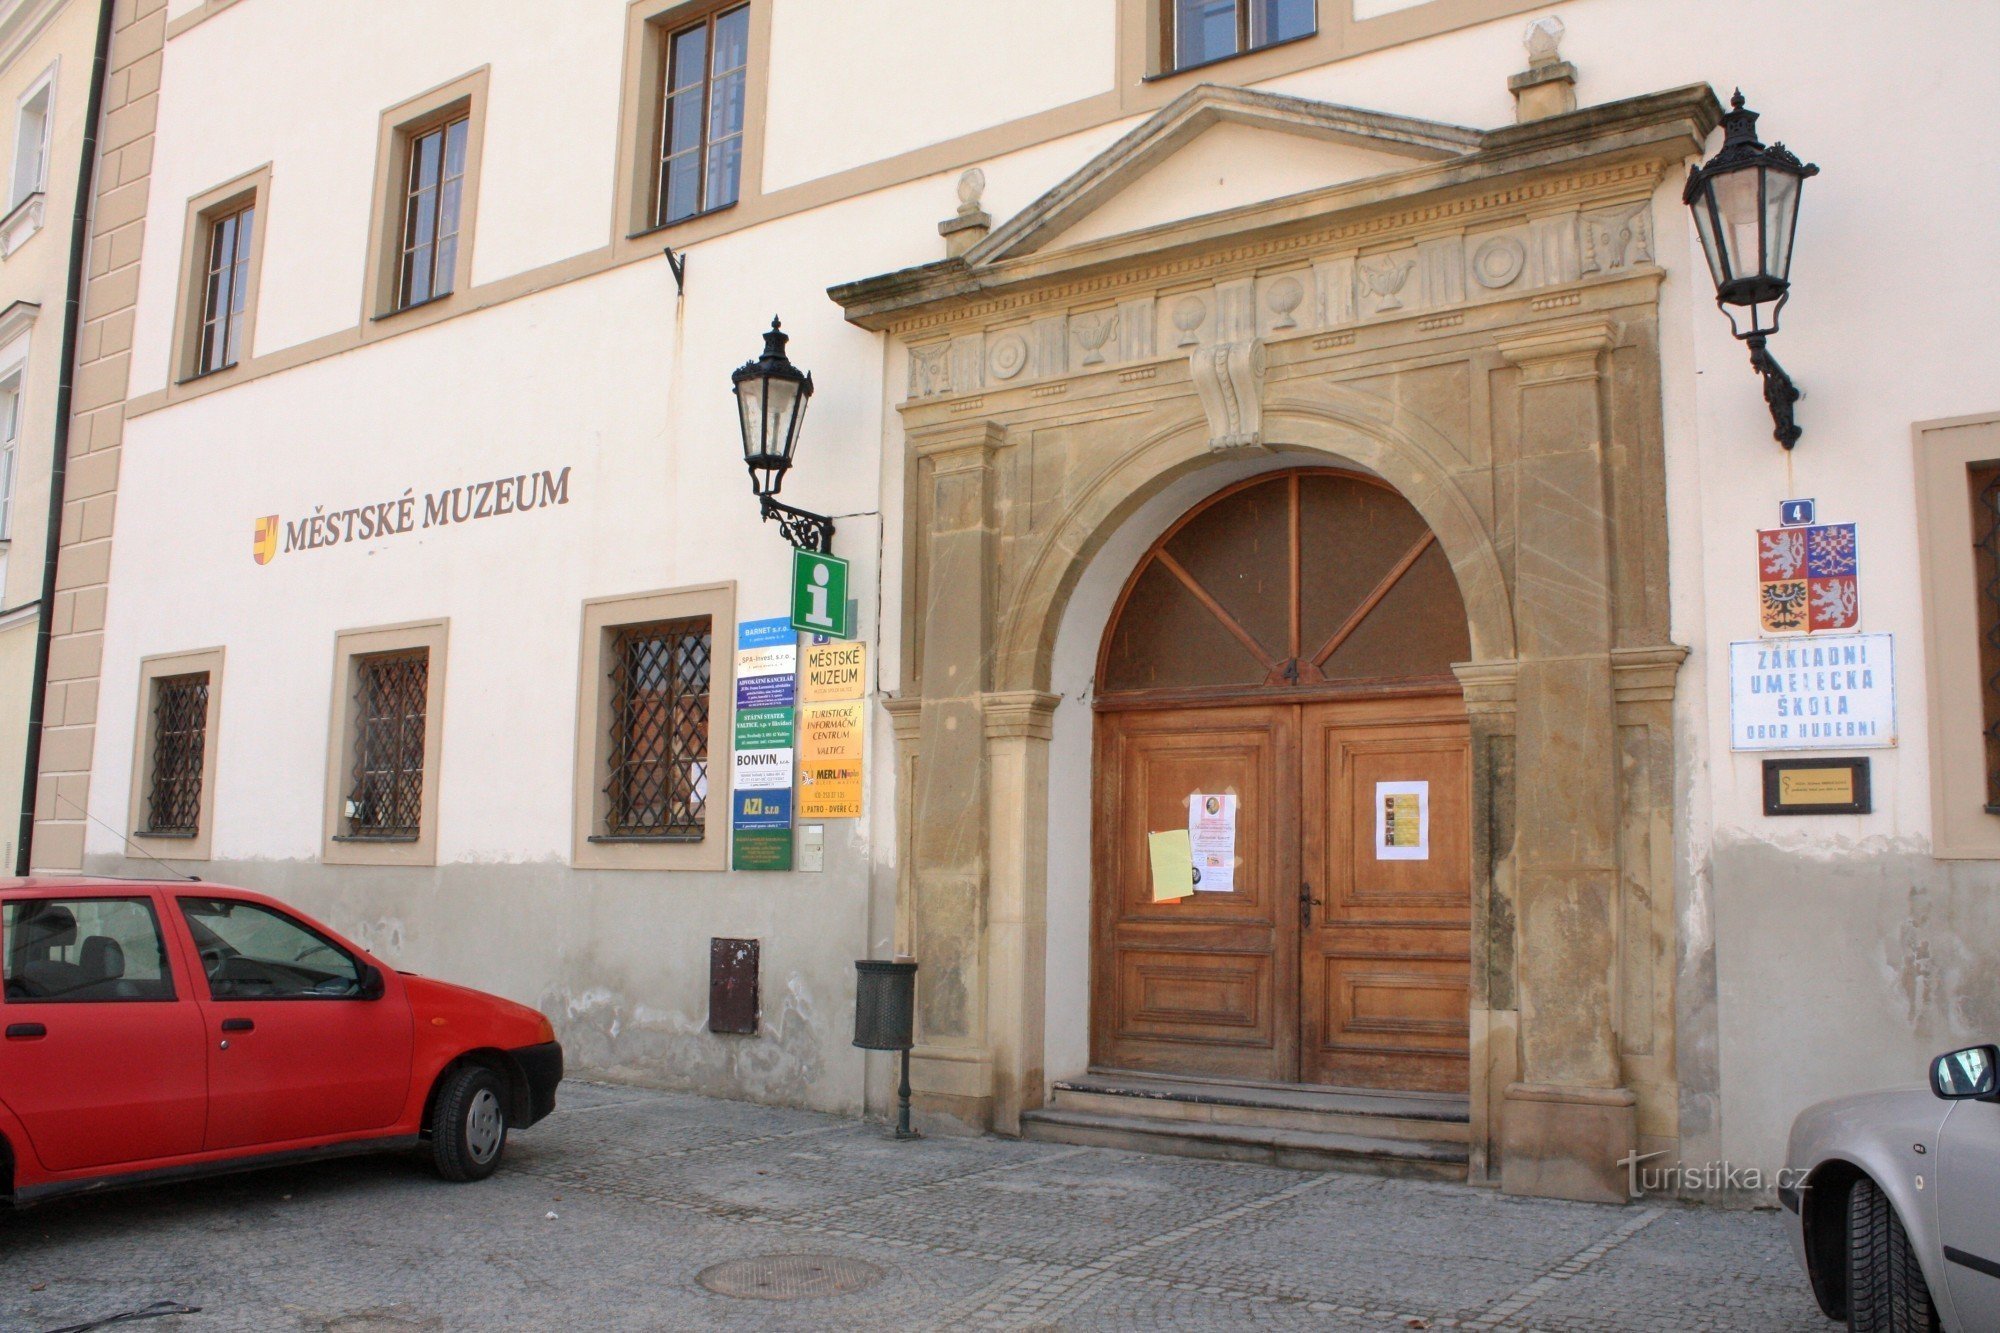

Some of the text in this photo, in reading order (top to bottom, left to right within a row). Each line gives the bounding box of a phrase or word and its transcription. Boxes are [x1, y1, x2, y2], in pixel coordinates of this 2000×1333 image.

[284, 466, 571, 553] MĚSTSKÉ MUZEUM
[1793, 505, 1801, 520] 4
[809, 646, 860, 668] MĚSTSKÉ
[810, 668, 858, 686] MUZEUM
[811, 706, 854, 719] TURISTICKÉ
[1777, 694, 1848, 717] ŠKOLA
[807, 716, 858, 730] INFORMAČNÍ
[812, 731, 850, 741] CENTRUM
[1747, 724, 1788, 739] OBOR
[817, 746, 846, 755] VALTICE
[743, 798, 763, 815] AZI
